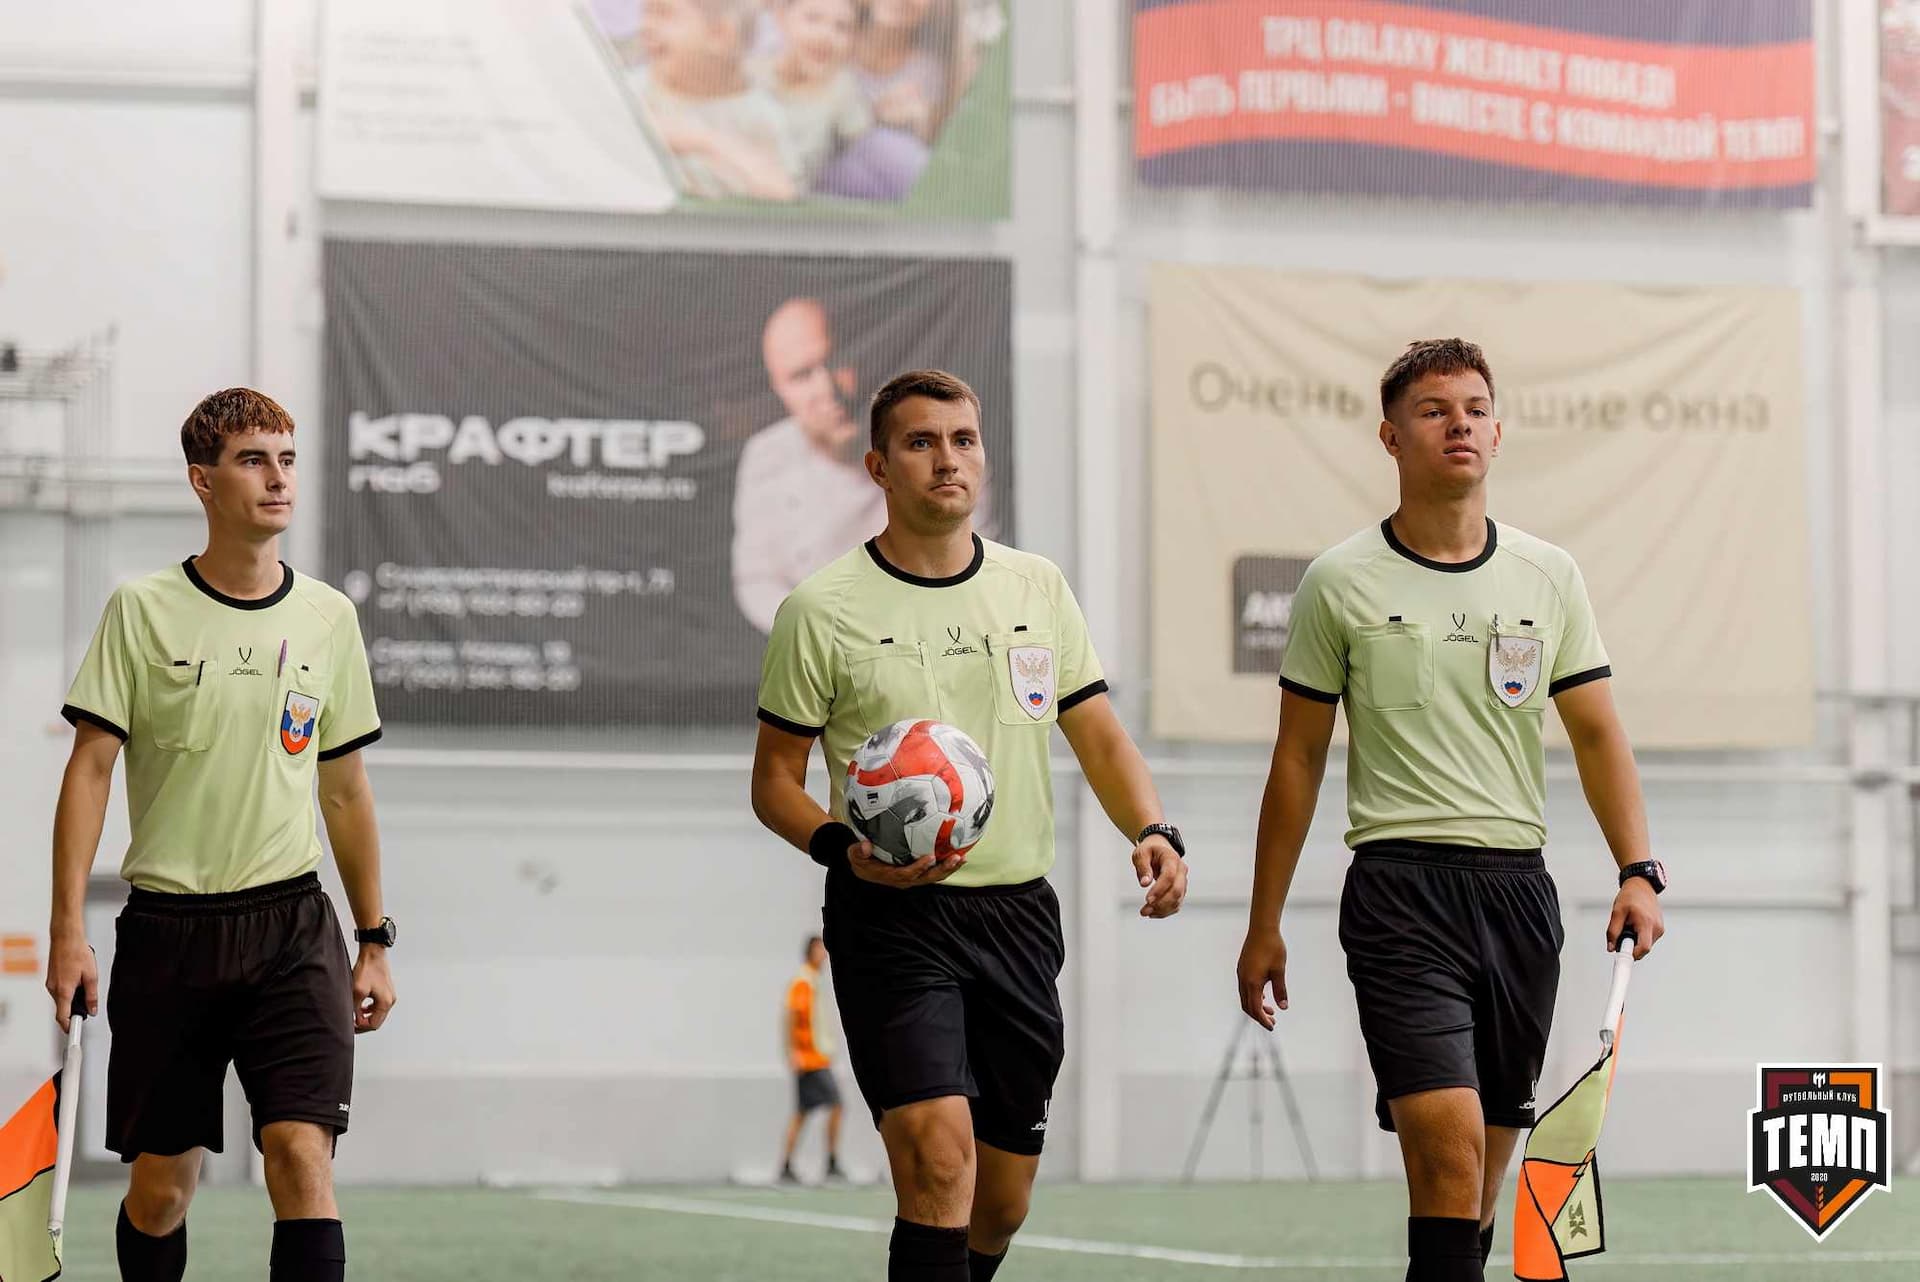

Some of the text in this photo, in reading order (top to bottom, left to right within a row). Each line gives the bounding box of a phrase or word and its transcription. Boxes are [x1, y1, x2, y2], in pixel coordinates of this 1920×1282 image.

[1326, 17, 1440, 72] GALAXY
[1530, 101, 1554, 144] С
[1188, 360, 1366, 422] Очень
[1640, 391, 1770, 434] окна
[348, 410, 706, 469] КРАФТЕР
[1443, 632, 1479, 643] JÖGEL
